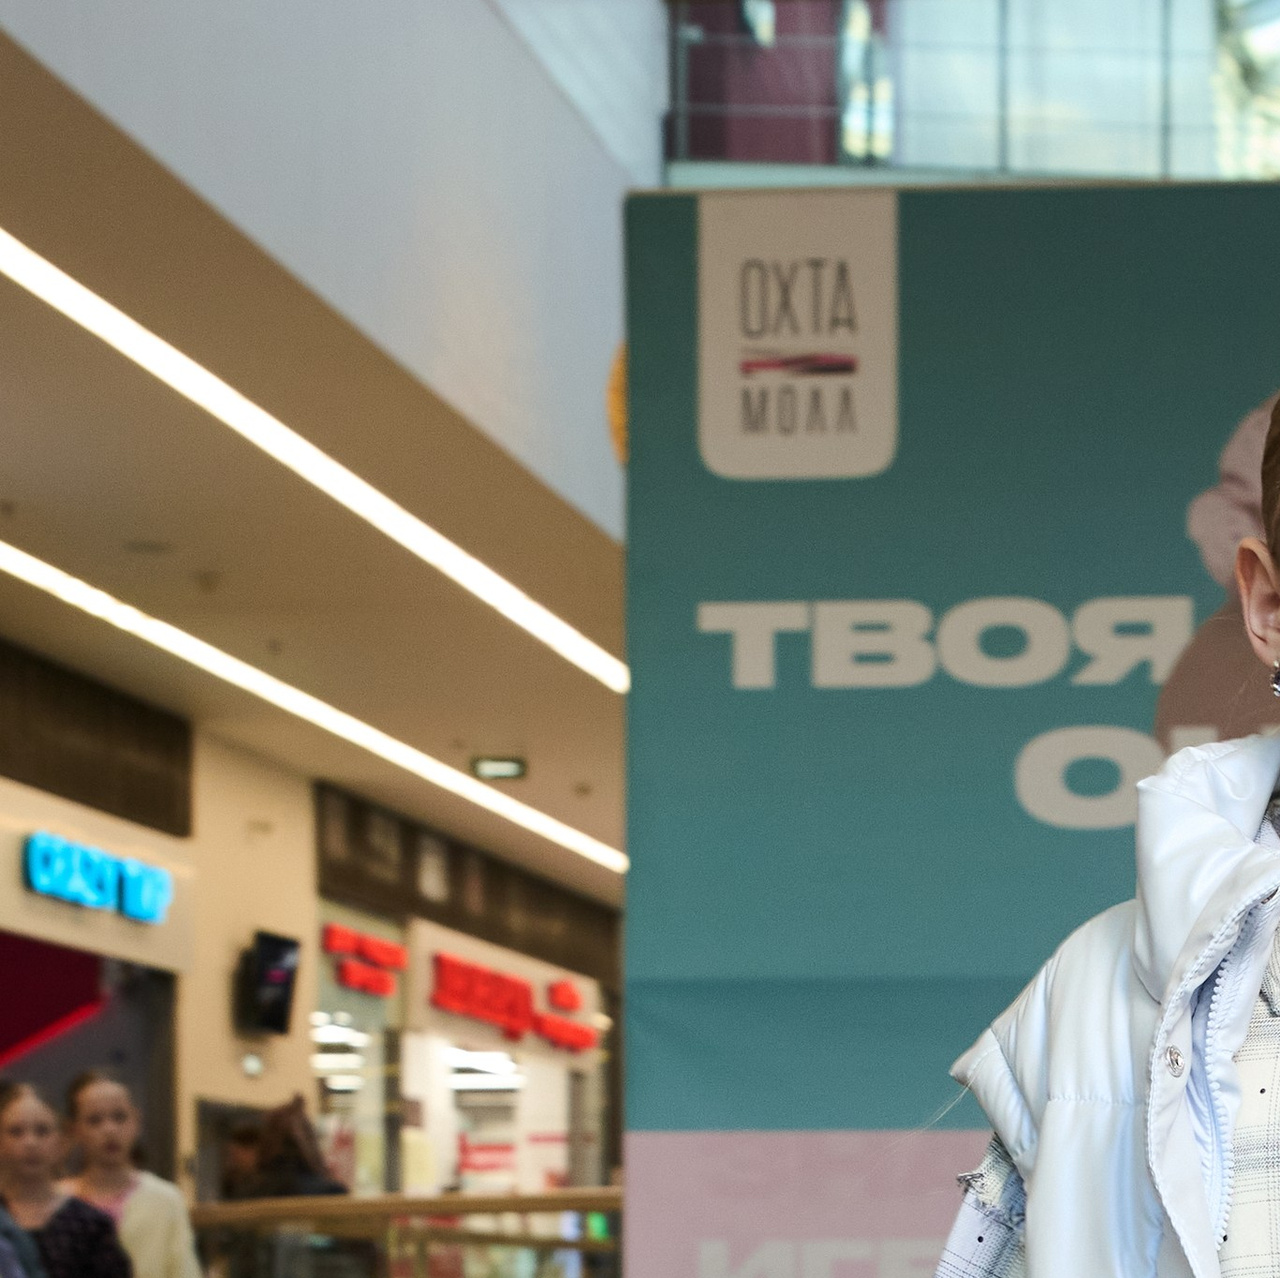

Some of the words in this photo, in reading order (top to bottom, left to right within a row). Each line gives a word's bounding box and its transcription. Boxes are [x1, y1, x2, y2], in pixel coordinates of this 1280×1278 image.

[738, 257, 859, 338] ОХТА
[739, 386, 859, 435] МОЛЛ
[697, 596, 1194, 688] ТВОЯ
